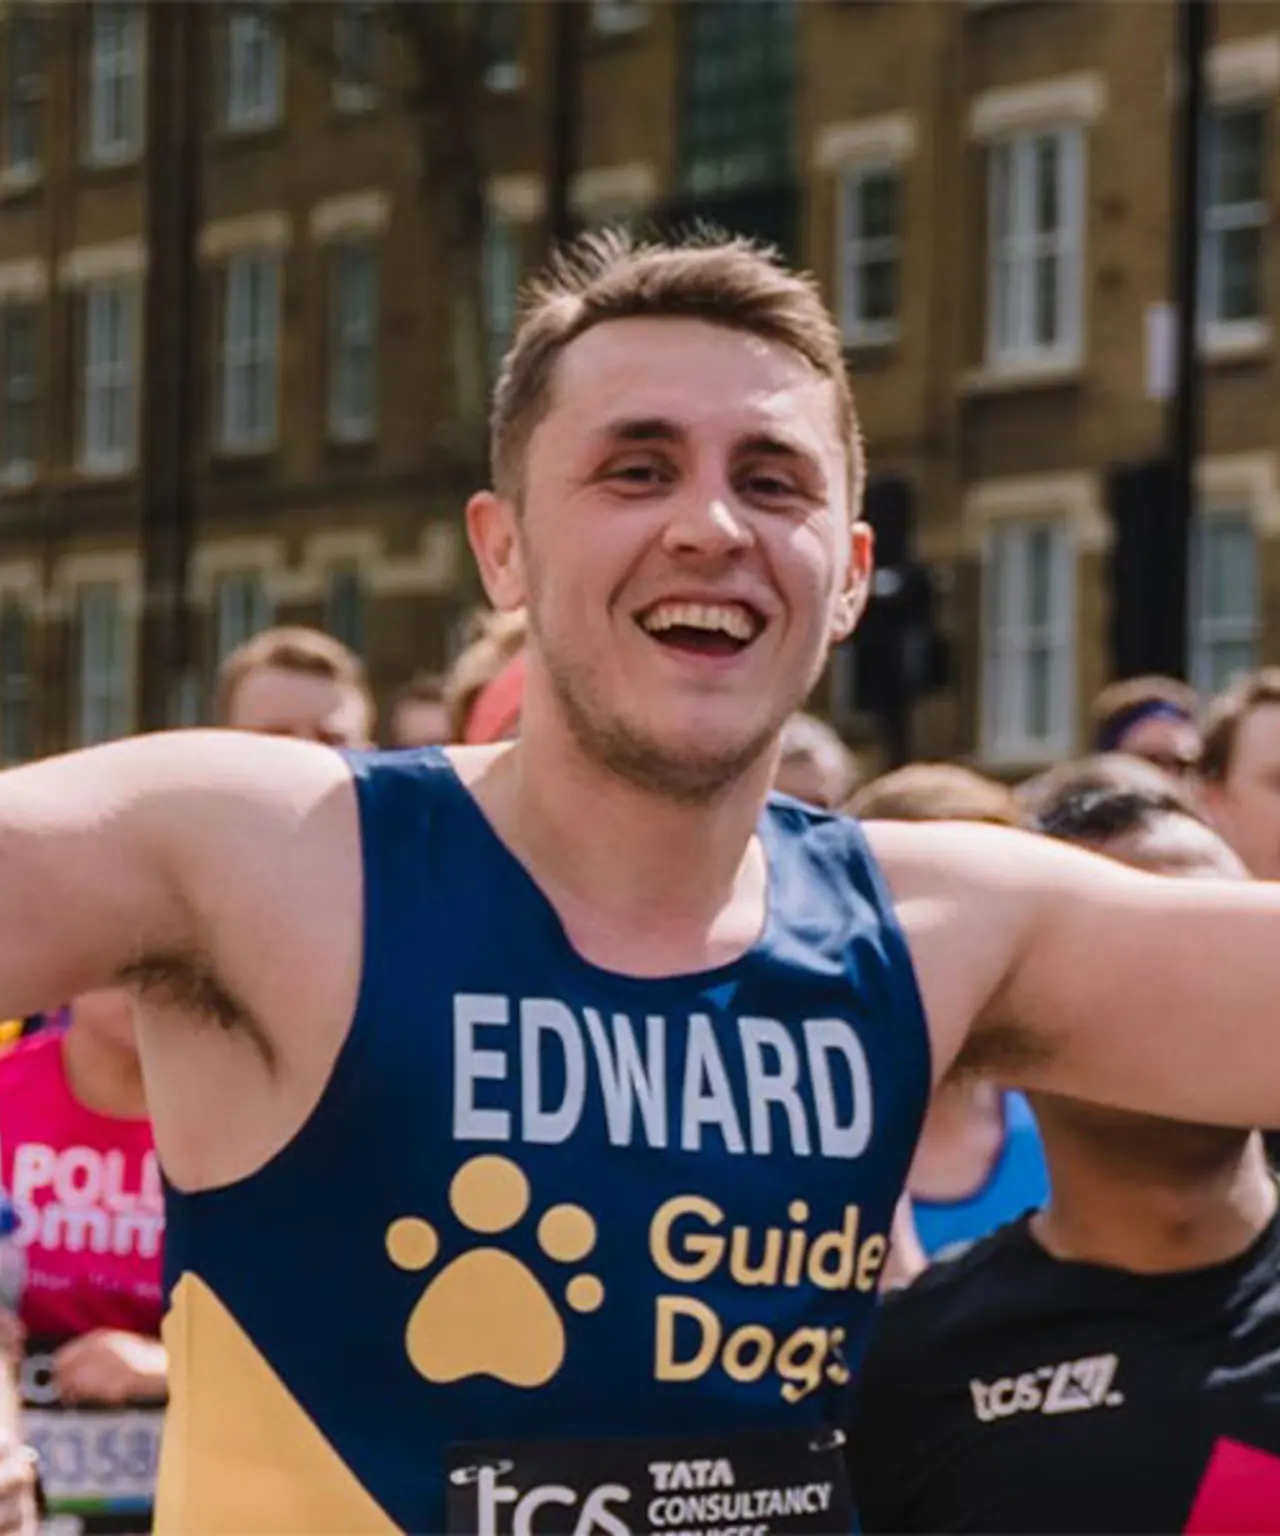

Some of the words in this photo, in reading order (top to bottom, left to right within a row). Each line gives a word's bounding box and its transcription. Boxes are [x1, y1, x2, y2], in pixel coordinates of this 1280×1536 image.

[452, 992, 874, 1159] EDWARD
[648, 1194, 888, 1292] Guide
[654, 1295, 850, 1403] Dogs
[647, 1482, 833, 1527] CONSULTANCY
[648, 1458, 735, 1491] TATA
